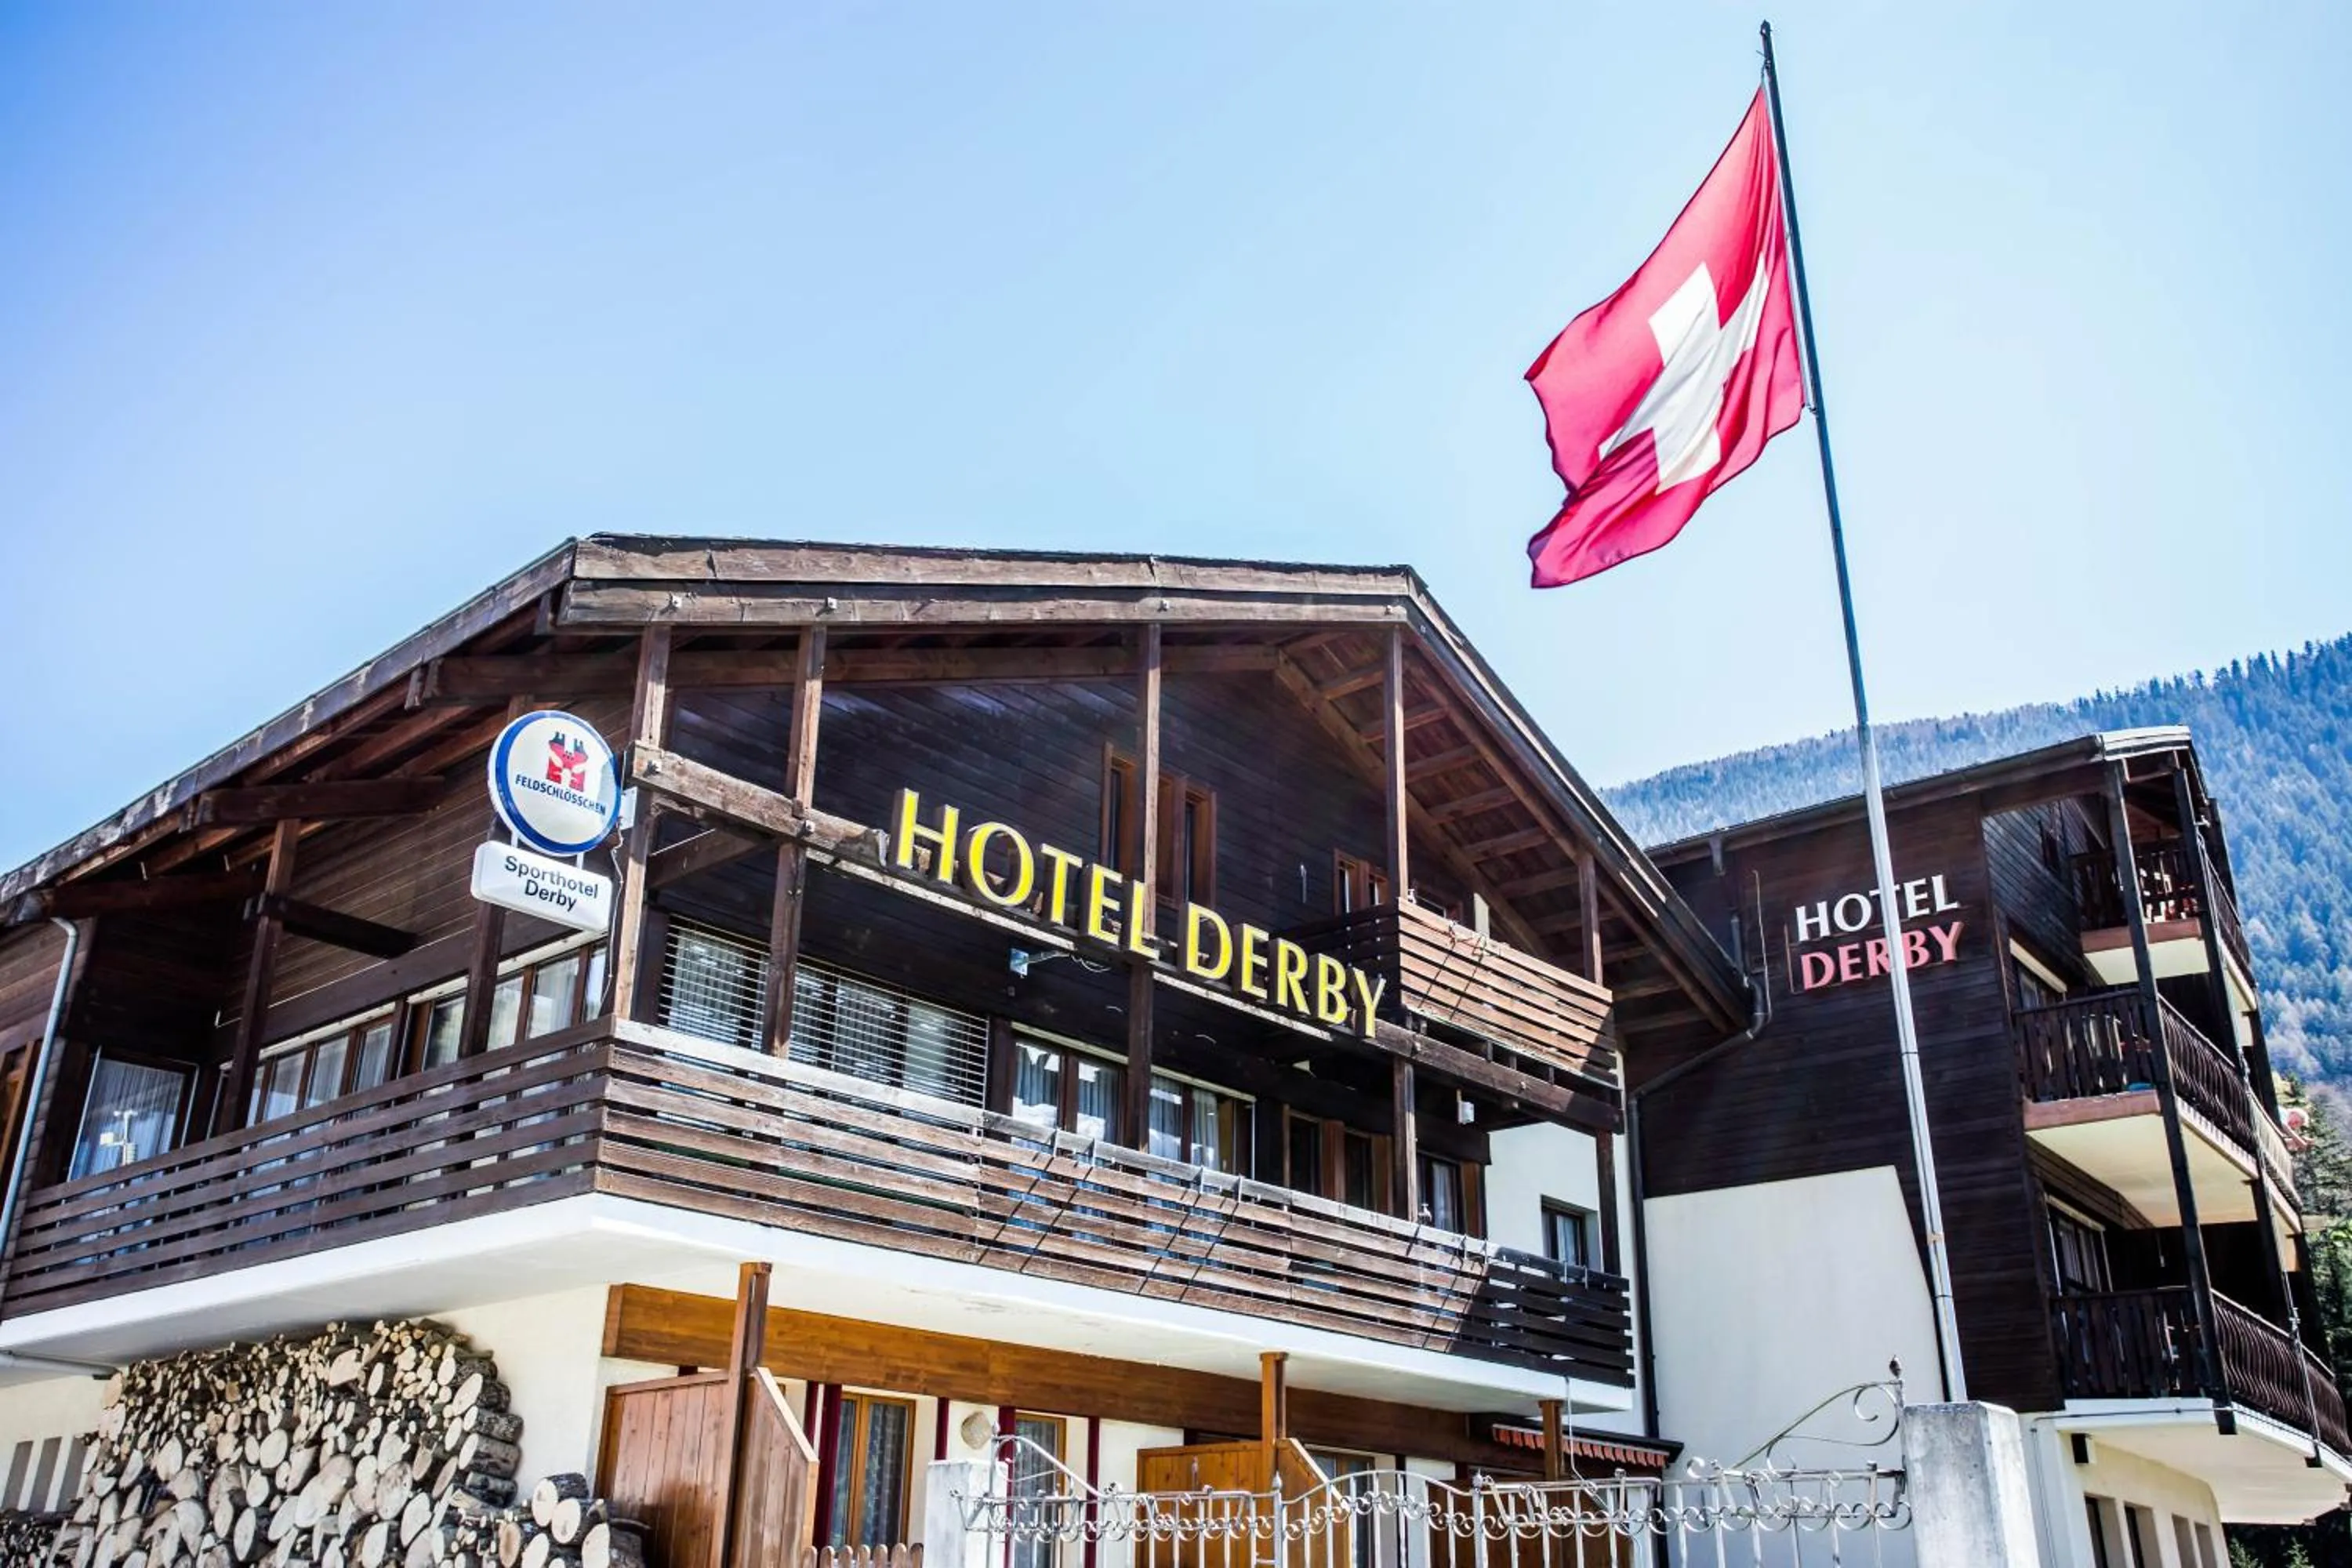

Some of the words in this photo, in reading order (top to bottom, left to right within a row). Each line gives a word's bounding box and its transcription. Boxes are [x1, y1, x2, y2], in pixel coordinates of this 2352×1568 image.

[515, 774, 606, 815] FELDSCHLÖSSCHEN
[505, 855, 598, 898] Sporthotel
[524, 880, 577, 912] Derby
[895, 787, 1160, 961] HOTEL
[1184, 901, 1387, 1039] DERBY
[1800, 920, 1964, 990] DERBY
